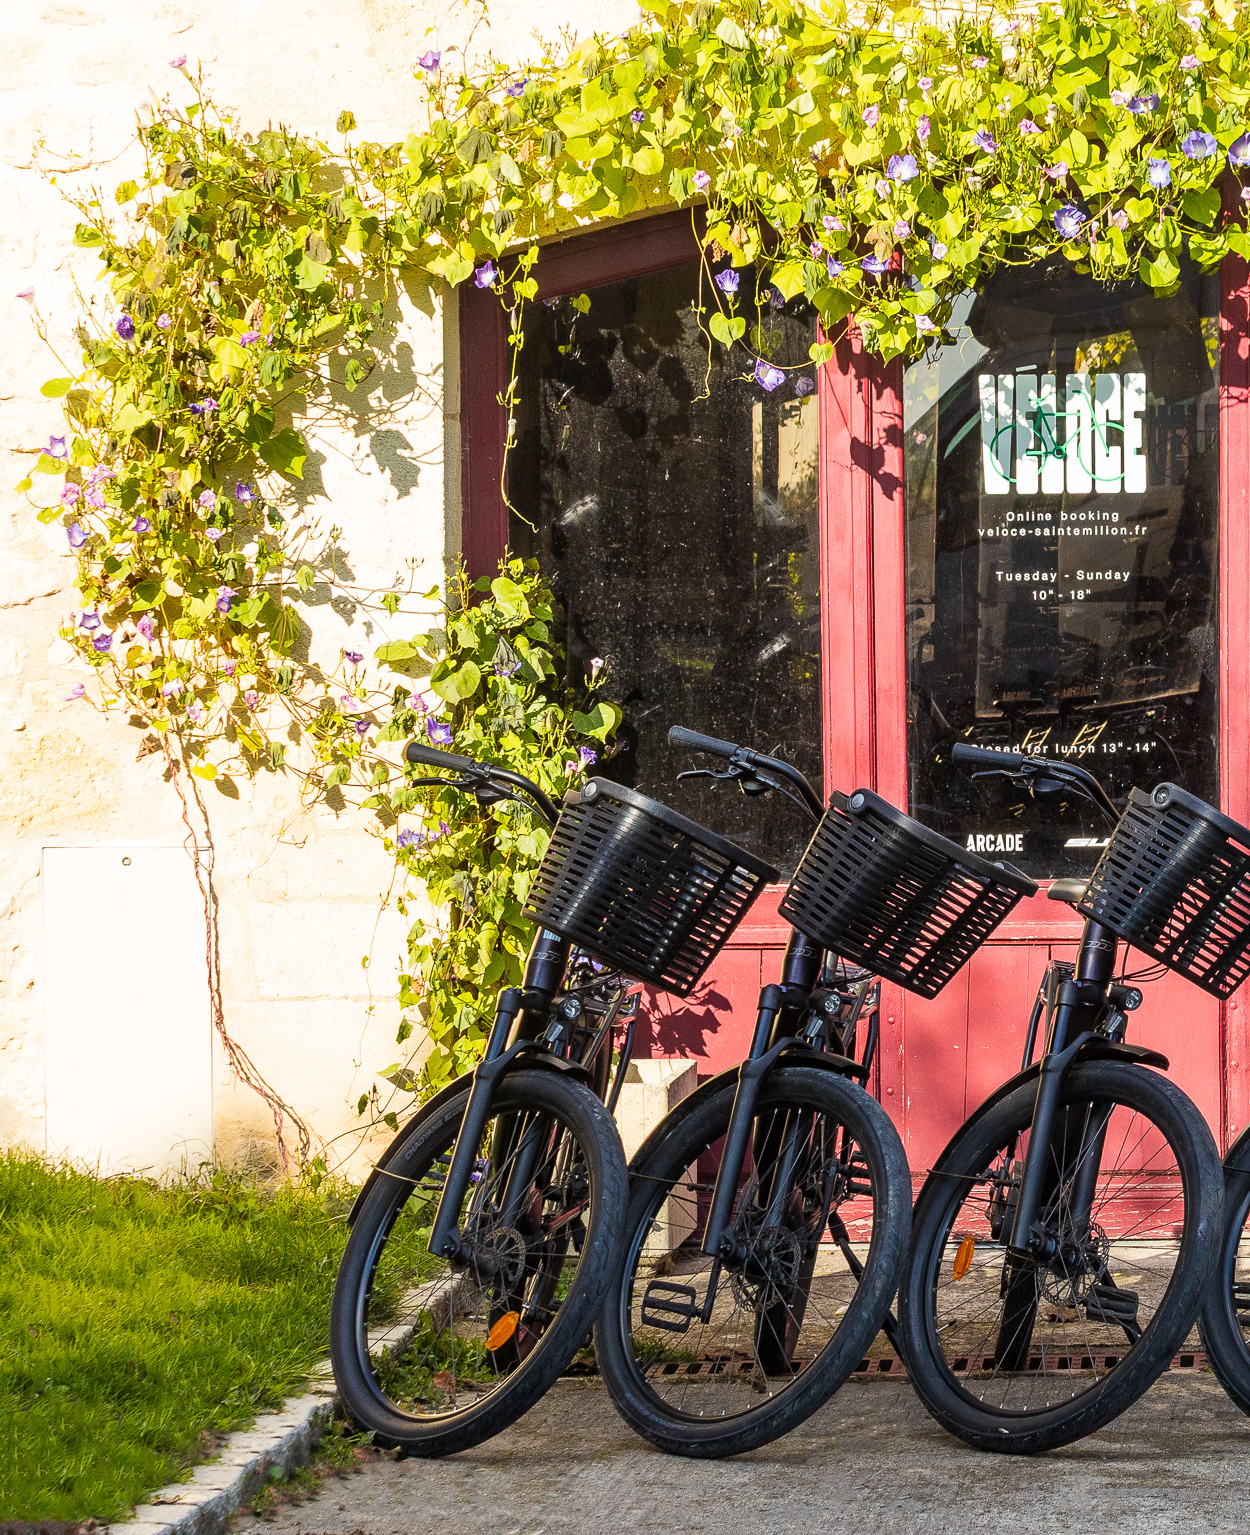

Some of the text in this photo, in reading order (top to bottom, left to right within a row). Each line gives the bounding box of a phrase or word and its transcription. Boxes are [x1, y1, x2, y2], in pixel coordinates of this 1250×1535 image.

[1006, 511, 1119, 522] Online booking
[978, 525, 1148, 537] veloce-saintemilion.fr
[996, 571, 1057, 582] Tuesday
[1076, 570, 1130, 582] Sunday
[1027, 743, 1049, 754] for
[1055, 743, 1095, 754] lunch
[965, 833, 1024, 852] ARCADE
